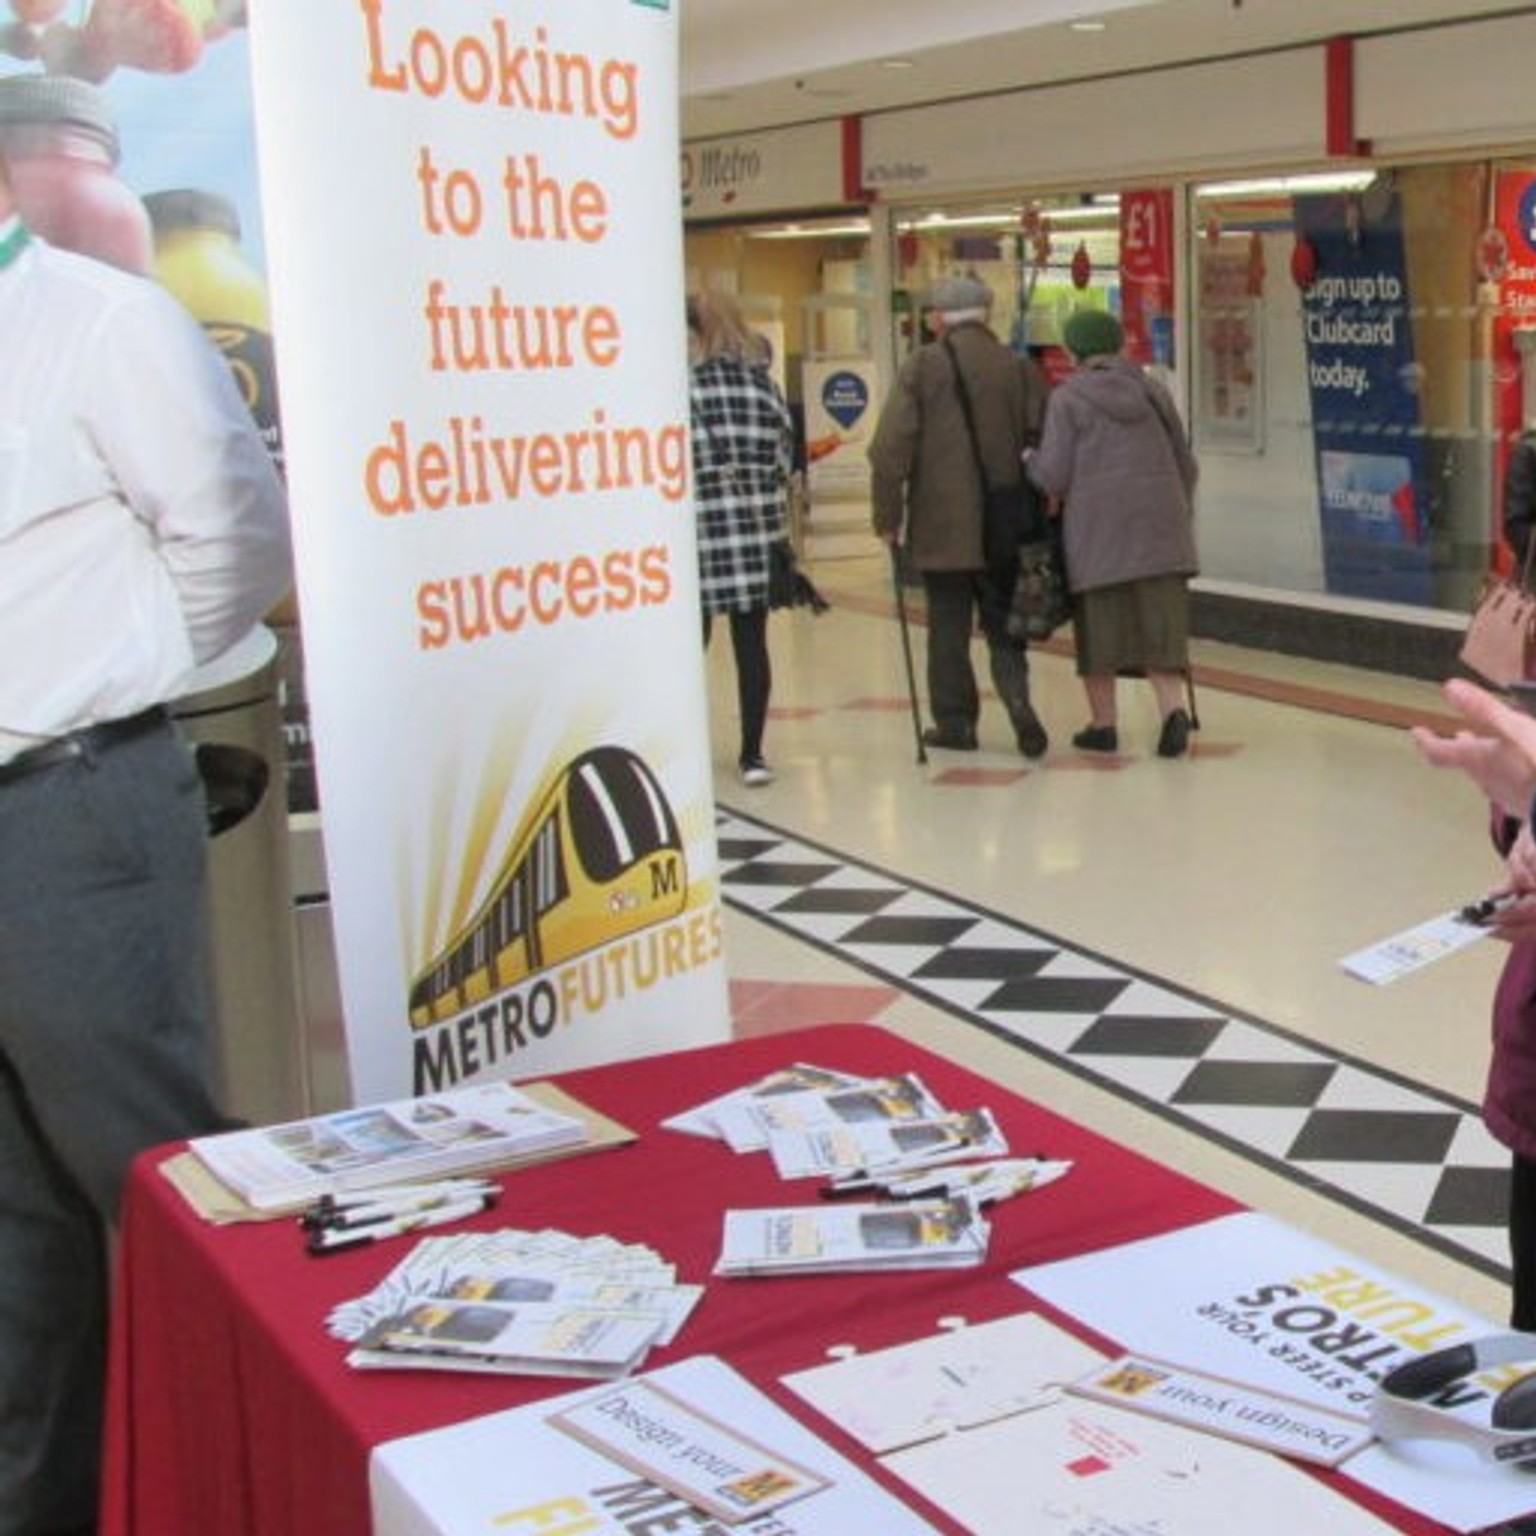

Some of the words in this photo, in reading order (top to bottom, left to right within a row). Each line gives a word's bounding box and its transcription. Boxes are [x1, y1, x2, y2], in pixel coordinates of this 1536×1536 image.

[361, 0, 639, 139] Looking
[417, 147, 483, 238] to
[504, 154, 609, 243] the
[1348, 278, 1376, 308] up
[1377, 270, 1401, 300] to
[424, 279, 622, 371] future
[1308, 312, 1394, 344] Clubcard
[1311, 358, 1370, 397] today.
[364, 409, 688, 517] delivering
[416, 543, 672, 650] success
[1269, 1342, 1355, 1391] STEER
[596, 1394, 683, 1450] Design
[1159, 1383, 1229, 1414] your
[1235, 1404, 1351, 1451] Design
